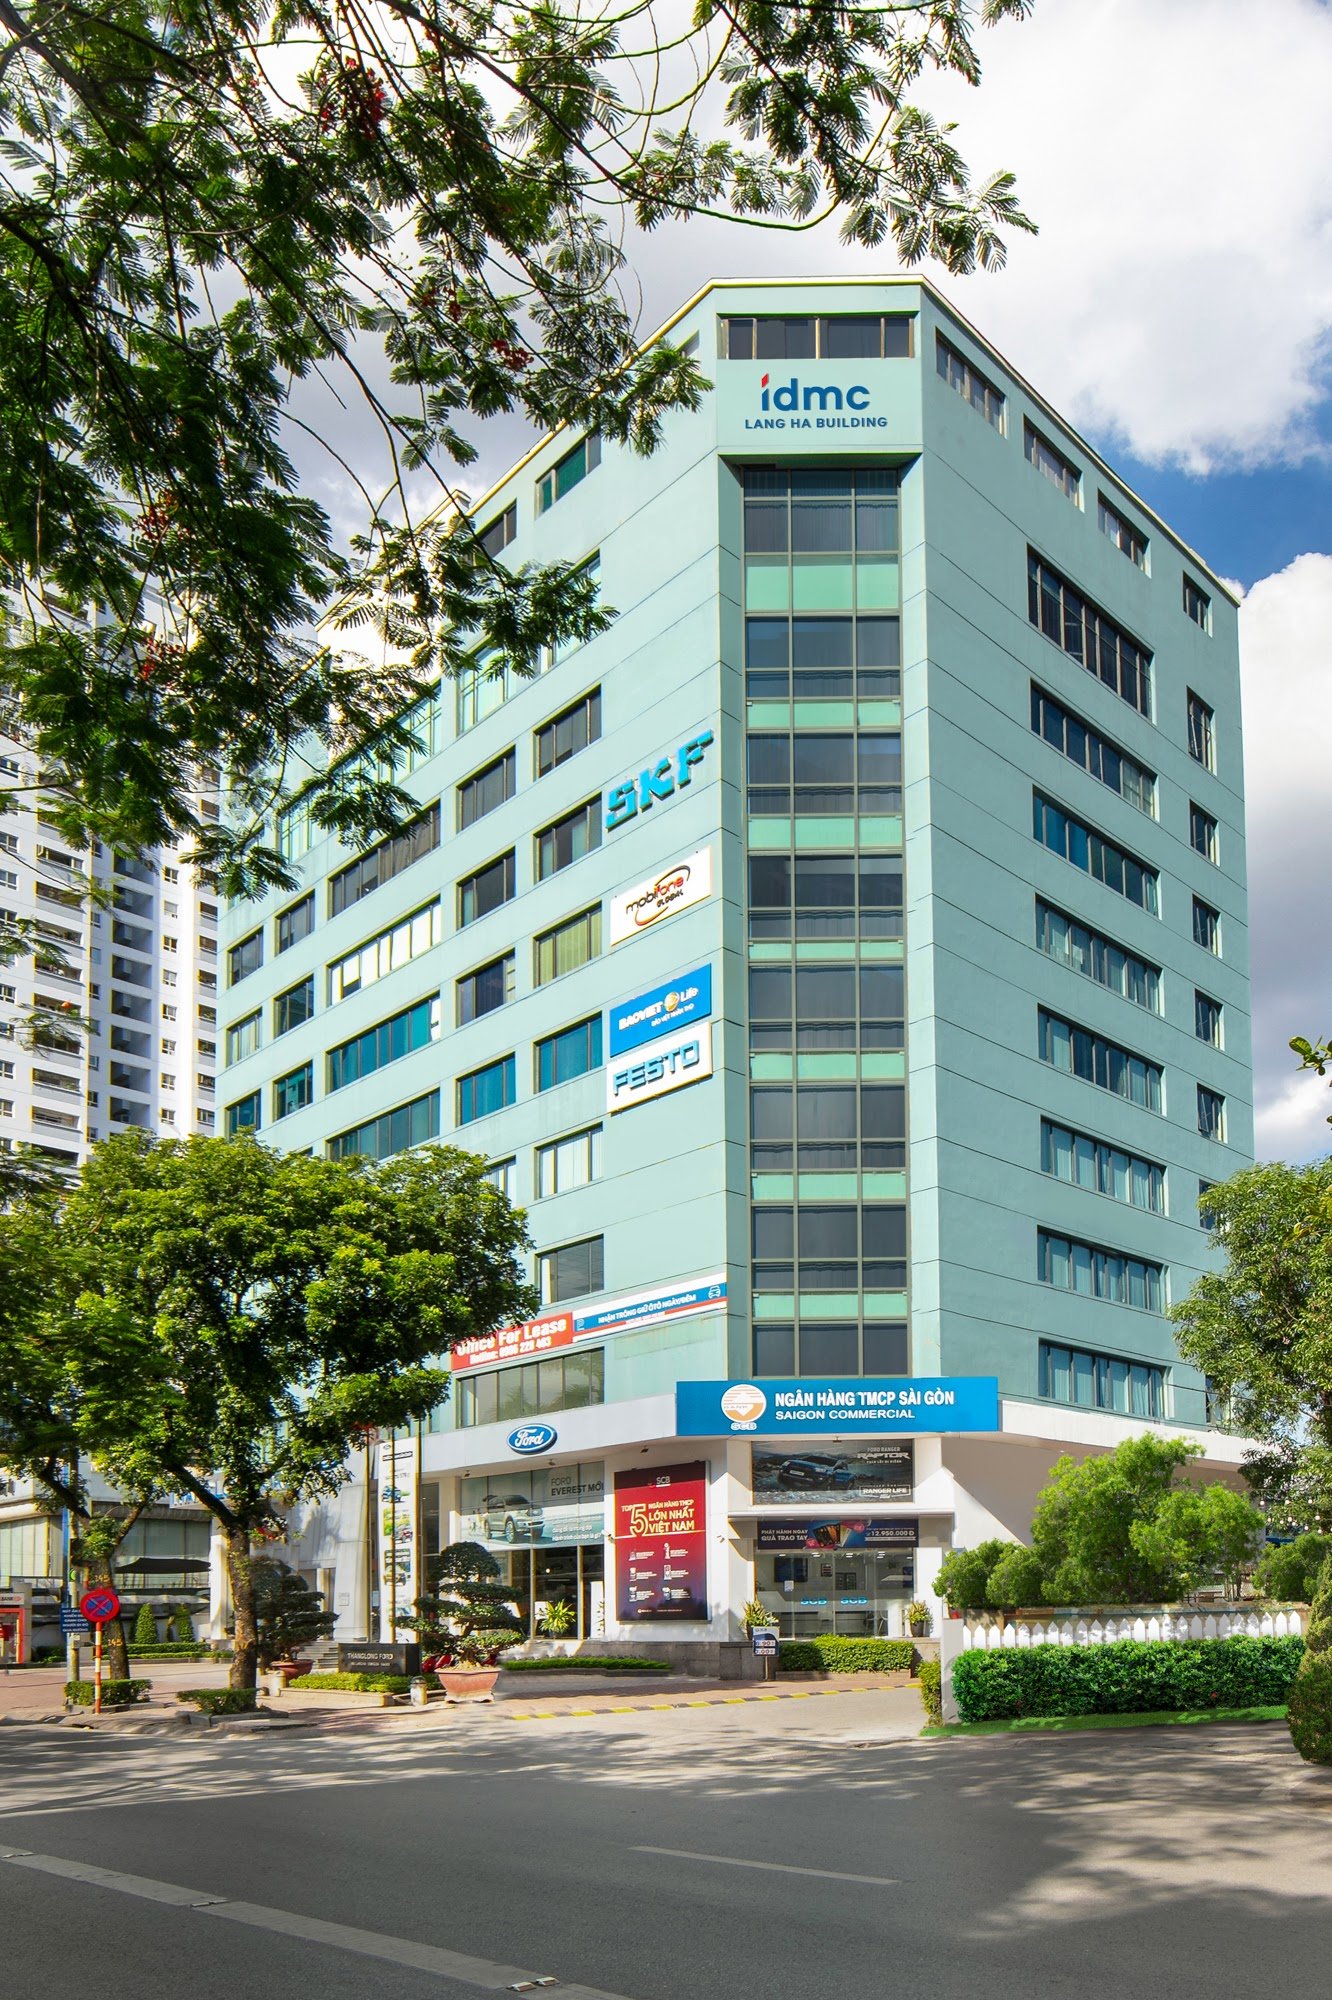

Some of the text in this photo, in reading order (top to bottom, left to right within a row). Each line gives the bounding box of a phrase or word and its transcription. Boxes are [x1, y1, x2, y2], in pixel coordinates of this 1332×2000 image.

[761, 373, 870, 411] idmc
[745, 416, 888, 429] LANG HA BUILDING
[606, 728, 714, 833] SKF
[626, 876, 684, 914] mobifone
[680, 987, 699, 1002] Life
[613, 1040, 700, 1097] FESTO
[498, 1328, 522, 1346] For
[523, 1319, 567, 1340] Lease
[775, 1387, 954, 1407] NGÂN HÀNG TMCP SÀI GÒN
[775, 1409, 915, 1420] SAIGON COMMERCIAL
[731, 1422, 757, 1430] SCB
[514, 1428, 545, 1447] Ford
[857, 1452, 911, 1460] RAPTOR
[551, 1477, 571, 1486] FORD
[656, 1476, 671, 1484] SCB
[551, 1484, 587, 1496] EVEREST
[648, 1501, 664, 1509] NGÂN
[630, 1503, 649, 1536] 5
[648, 1505, 695, 1521] LỚN NHẤT
[648, 1519, 695, 1533] VIỆT NAM
